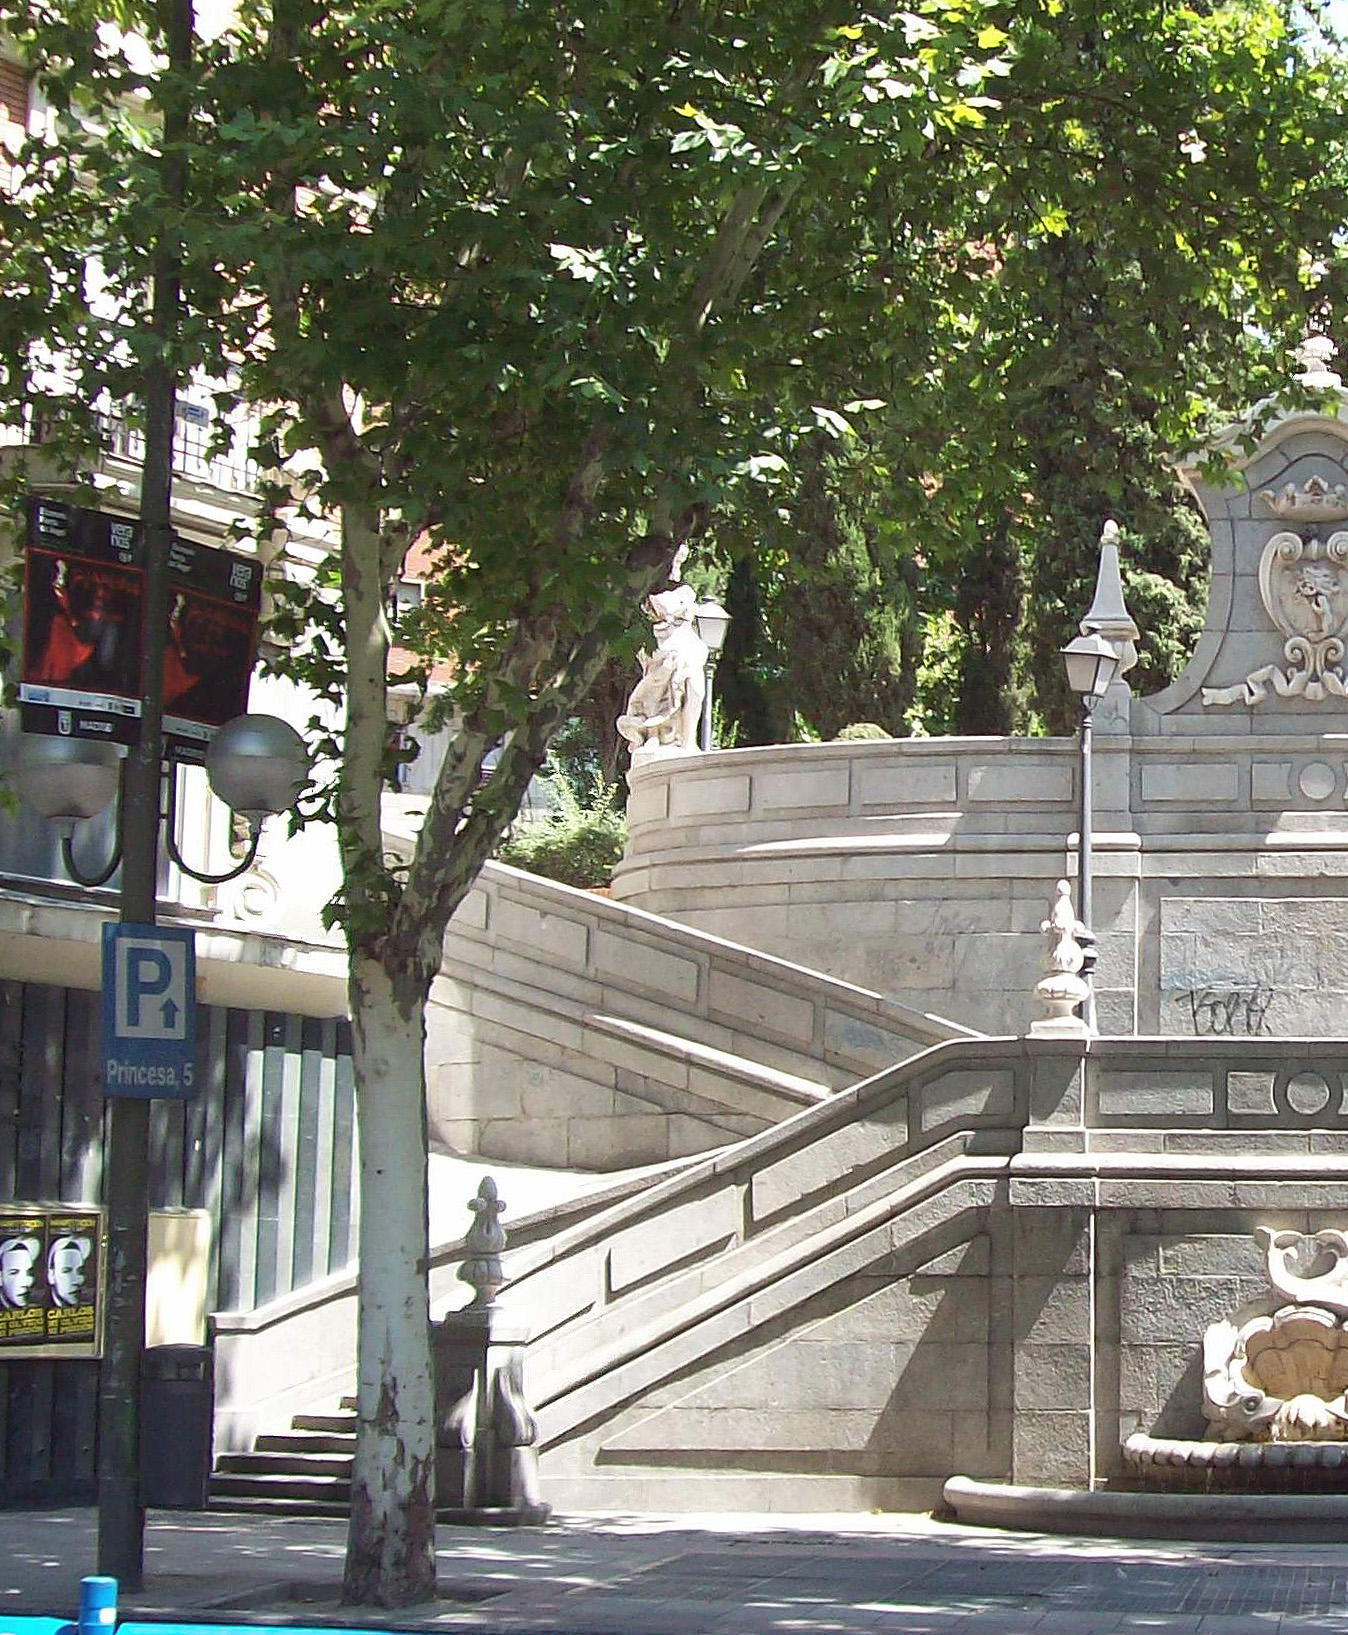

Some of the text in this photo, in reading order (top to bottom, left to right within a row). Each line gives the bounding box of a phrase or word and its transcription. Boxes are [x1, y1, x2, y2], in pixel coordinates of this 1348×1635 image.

[127, 948, 172, 1027] P
[107, 1058, 194, 1088] Princesa, 5
